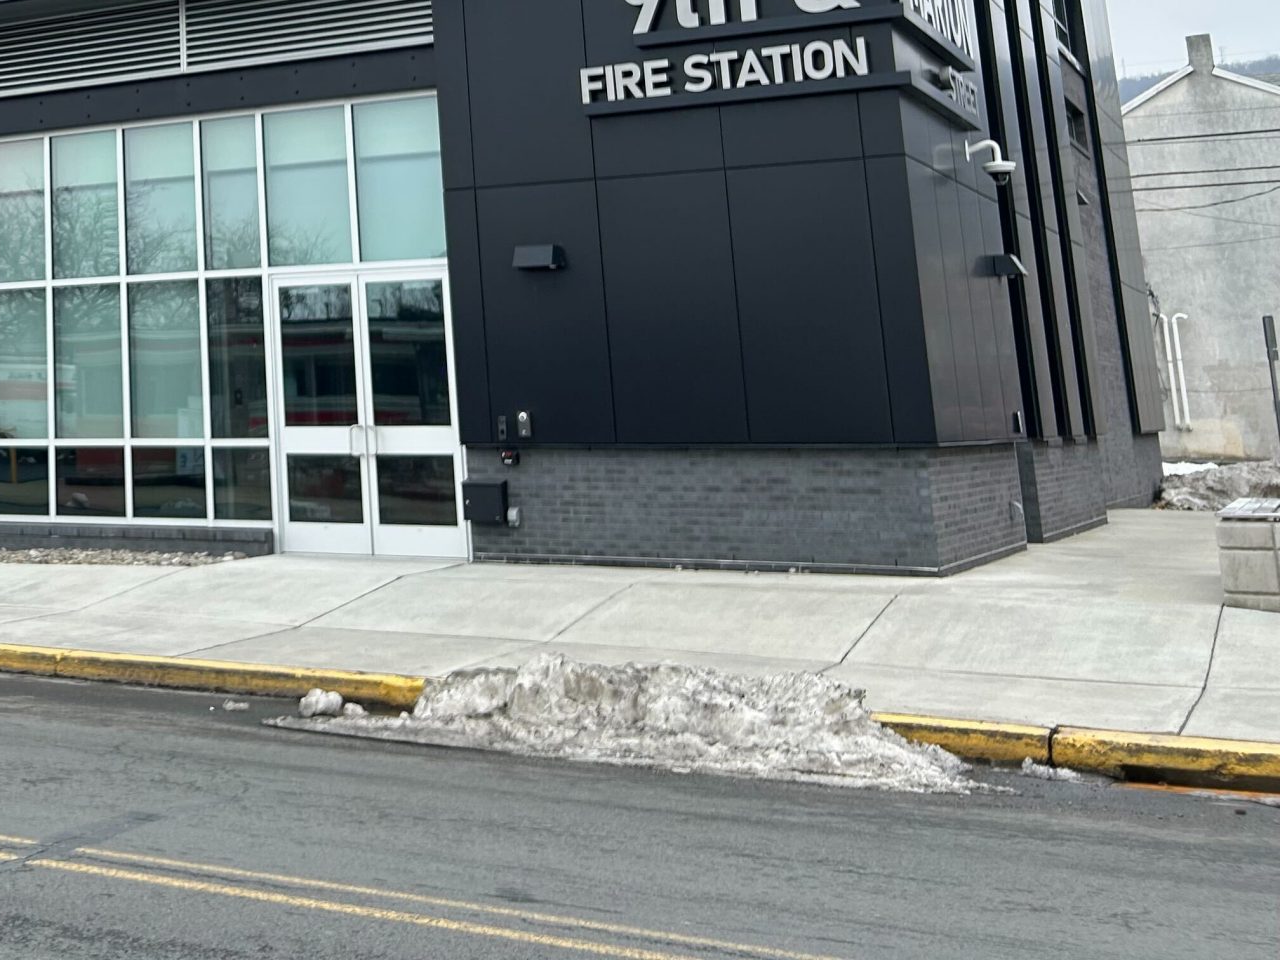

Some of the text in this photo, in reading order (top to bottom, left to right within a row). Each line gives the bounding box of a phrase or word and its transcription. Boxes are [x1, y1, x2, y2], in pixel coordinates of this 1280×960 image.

[579, 36, 869, 105] FIRE STATION
[948, 64, 980, 119] STREET
